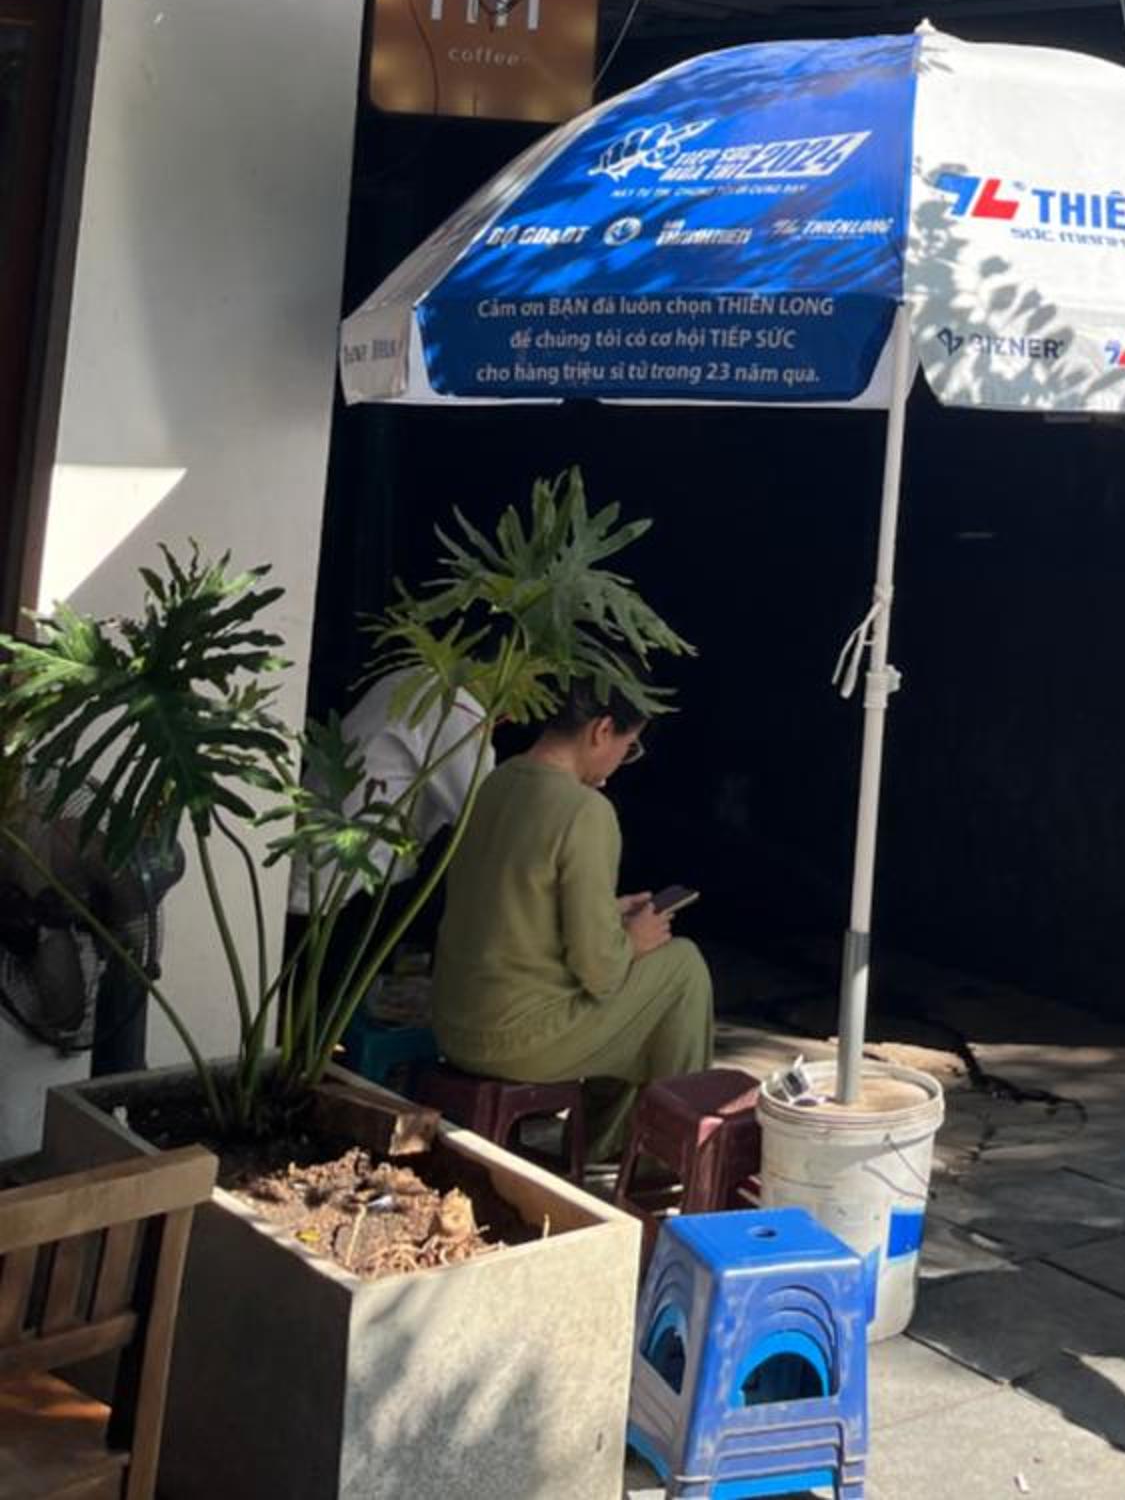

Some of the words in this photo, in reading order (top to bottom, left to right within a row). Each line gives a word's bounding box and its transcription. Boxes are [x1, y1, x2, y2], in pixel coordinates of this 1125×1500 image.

[448, 47, 521, 67] coffee
[548, 298, 590, 320] BẠN
[619, 296, 662, 315] luôn
[666, 297, 712, 320] chọn
[717, 293, 774, 315] THIÊN
[779, 297, 834, 316] LONG
[535, 328, 592, 352] chúng
[595, 329, 622, 347] tôi
[625, 330, 647, 347] có
[650, 332, 674, 347] cơ
[675, 329, 706, 352] hội
[709, 325, 752, 348] TIẾP
[755, 325, 798, 349] SỨC
[476, 362, 511, 382] cho
[513, 361, 561, 385] hàng
[563, 360, 606, 384] triệu
[706, 361, 732, 381] 23
[735, 363, 780, 383] năm
